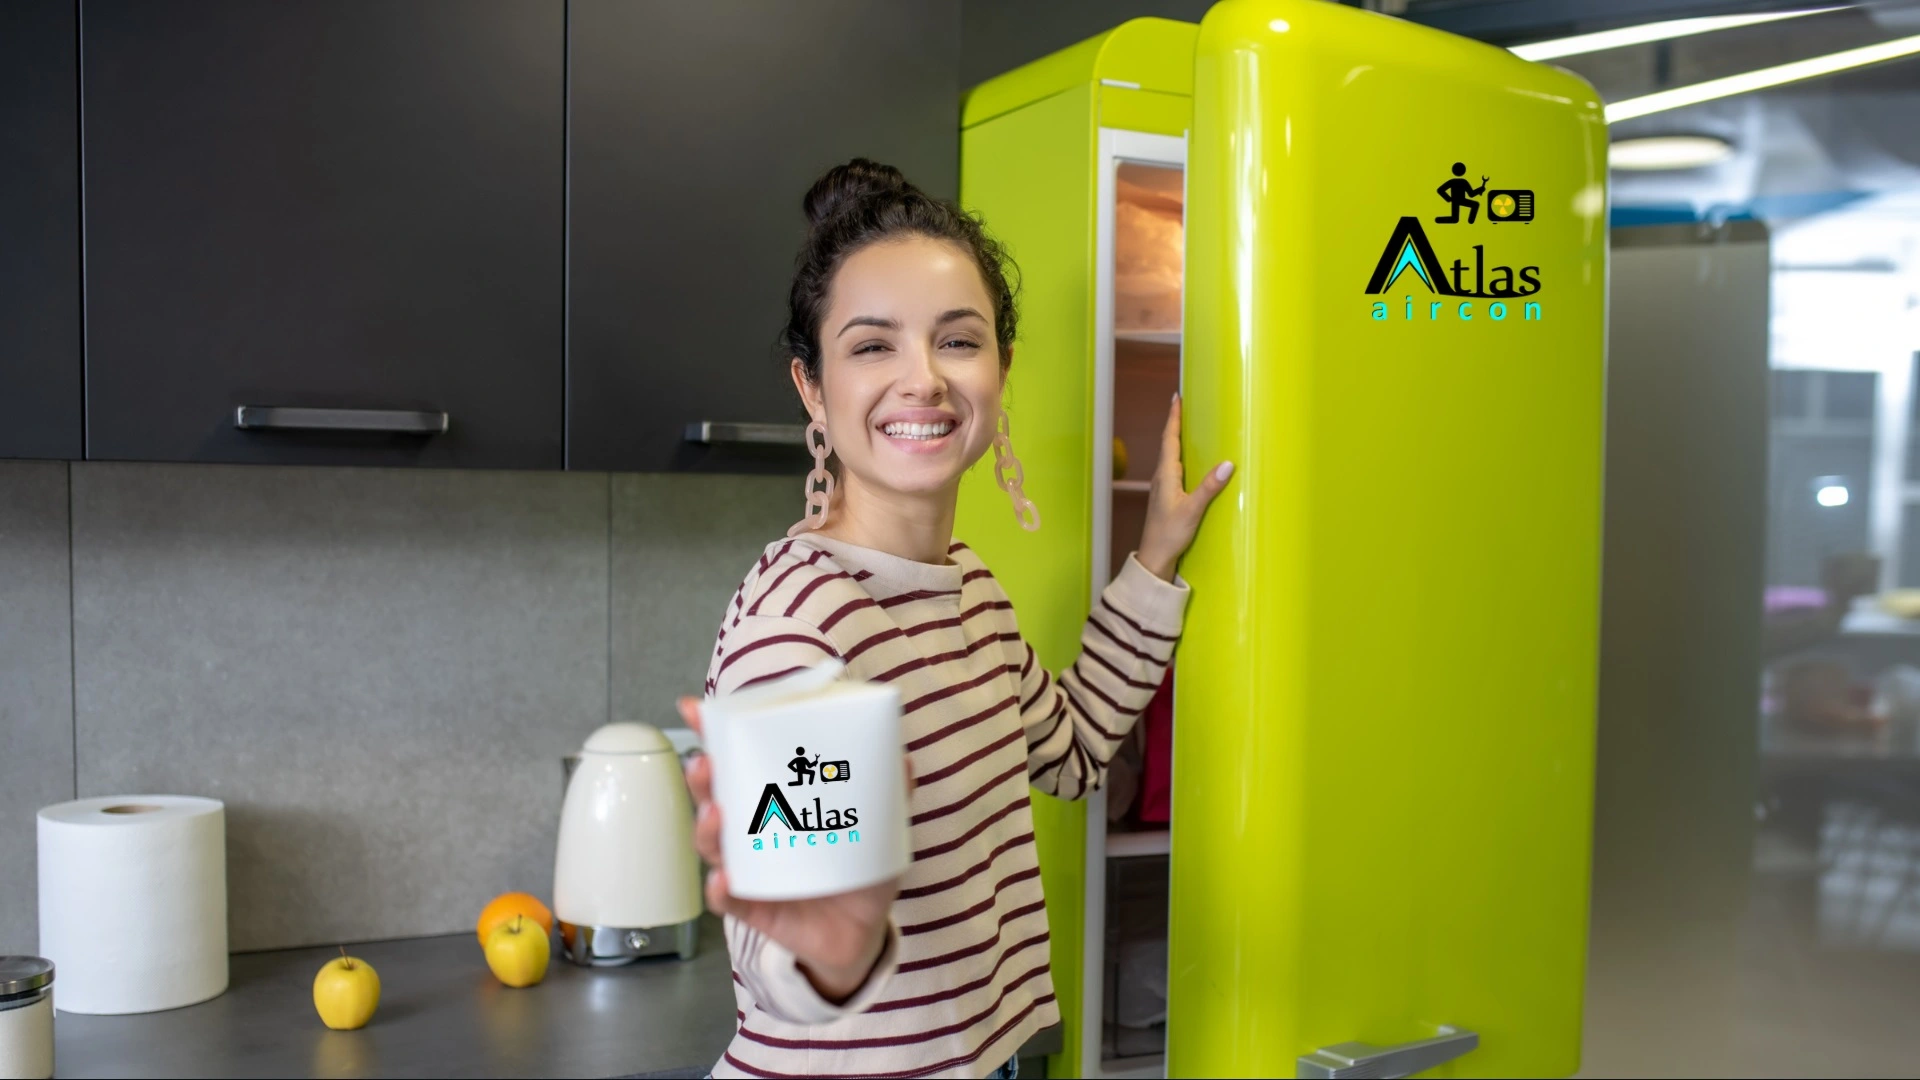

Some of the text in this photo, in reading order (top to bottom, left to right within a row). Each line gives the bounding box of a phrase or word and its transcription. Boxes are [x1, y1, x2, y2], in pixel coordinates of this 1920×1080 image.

[1364, 216, 1542, 299] Atlas
[1371, 295, 1542, 321] aircon
[747, 783, 859, 835] Atlas
[752, 829, 861, 851] aircon
